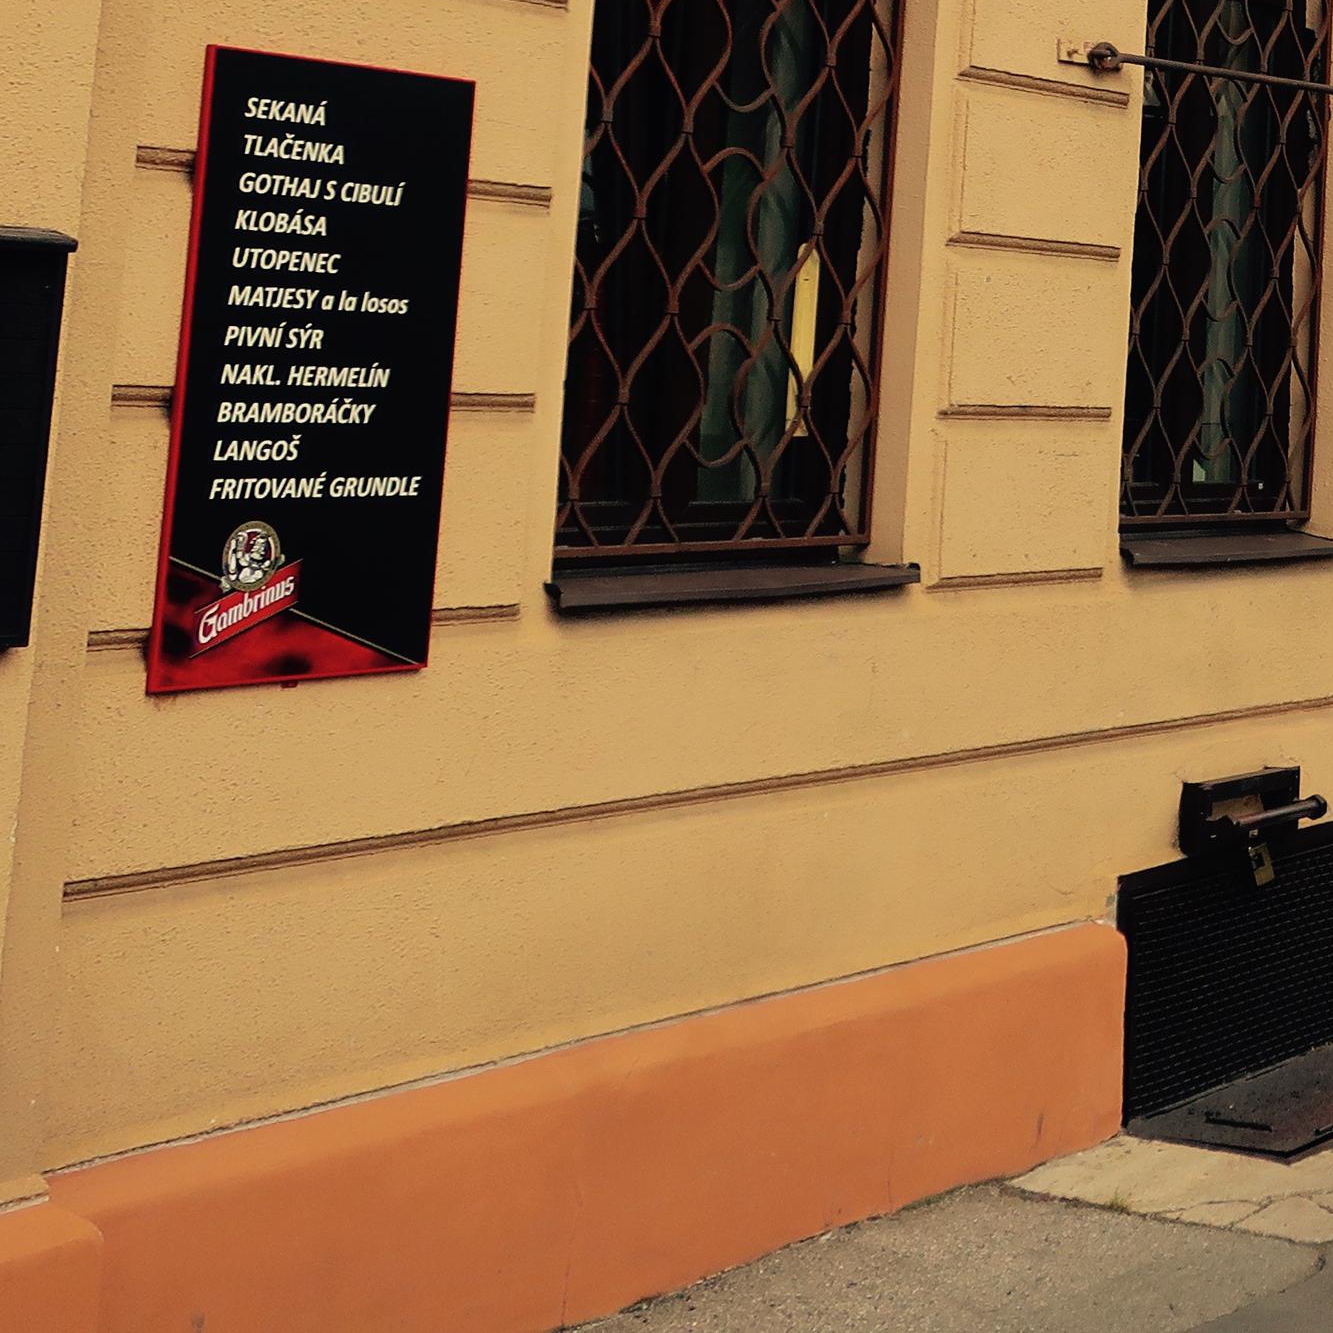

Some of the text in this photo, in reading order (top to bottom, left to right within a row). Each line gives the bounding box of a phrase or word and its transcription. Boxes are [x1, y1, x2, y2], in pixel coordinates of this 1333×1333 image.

[244, 96, 328, 126] SEKANÁ
[243, 133, 345, 165] TLAČENKA
[239, 172, 406, 207] GOTHAJ S CIBULÍ
[234, 208, 328, 236] KLOBÁSA
[232, 247, 341, 274] UTOPENEC
[227, 285, 410, 315] MATJESY a la losos
[224, 321, 325, 349] PIVNÍ SÝR
[220, 362, 391, 388] NAKL. HERMELÍN
[217, 397, 376, 424] BRAMBORÁČKY
[213, 434, 302, 461] LANGOŠ
[209, 471, 422, 500] FRITOVANÉ GRUNDLE
[198, 576, 294, 644] Gambrinus
